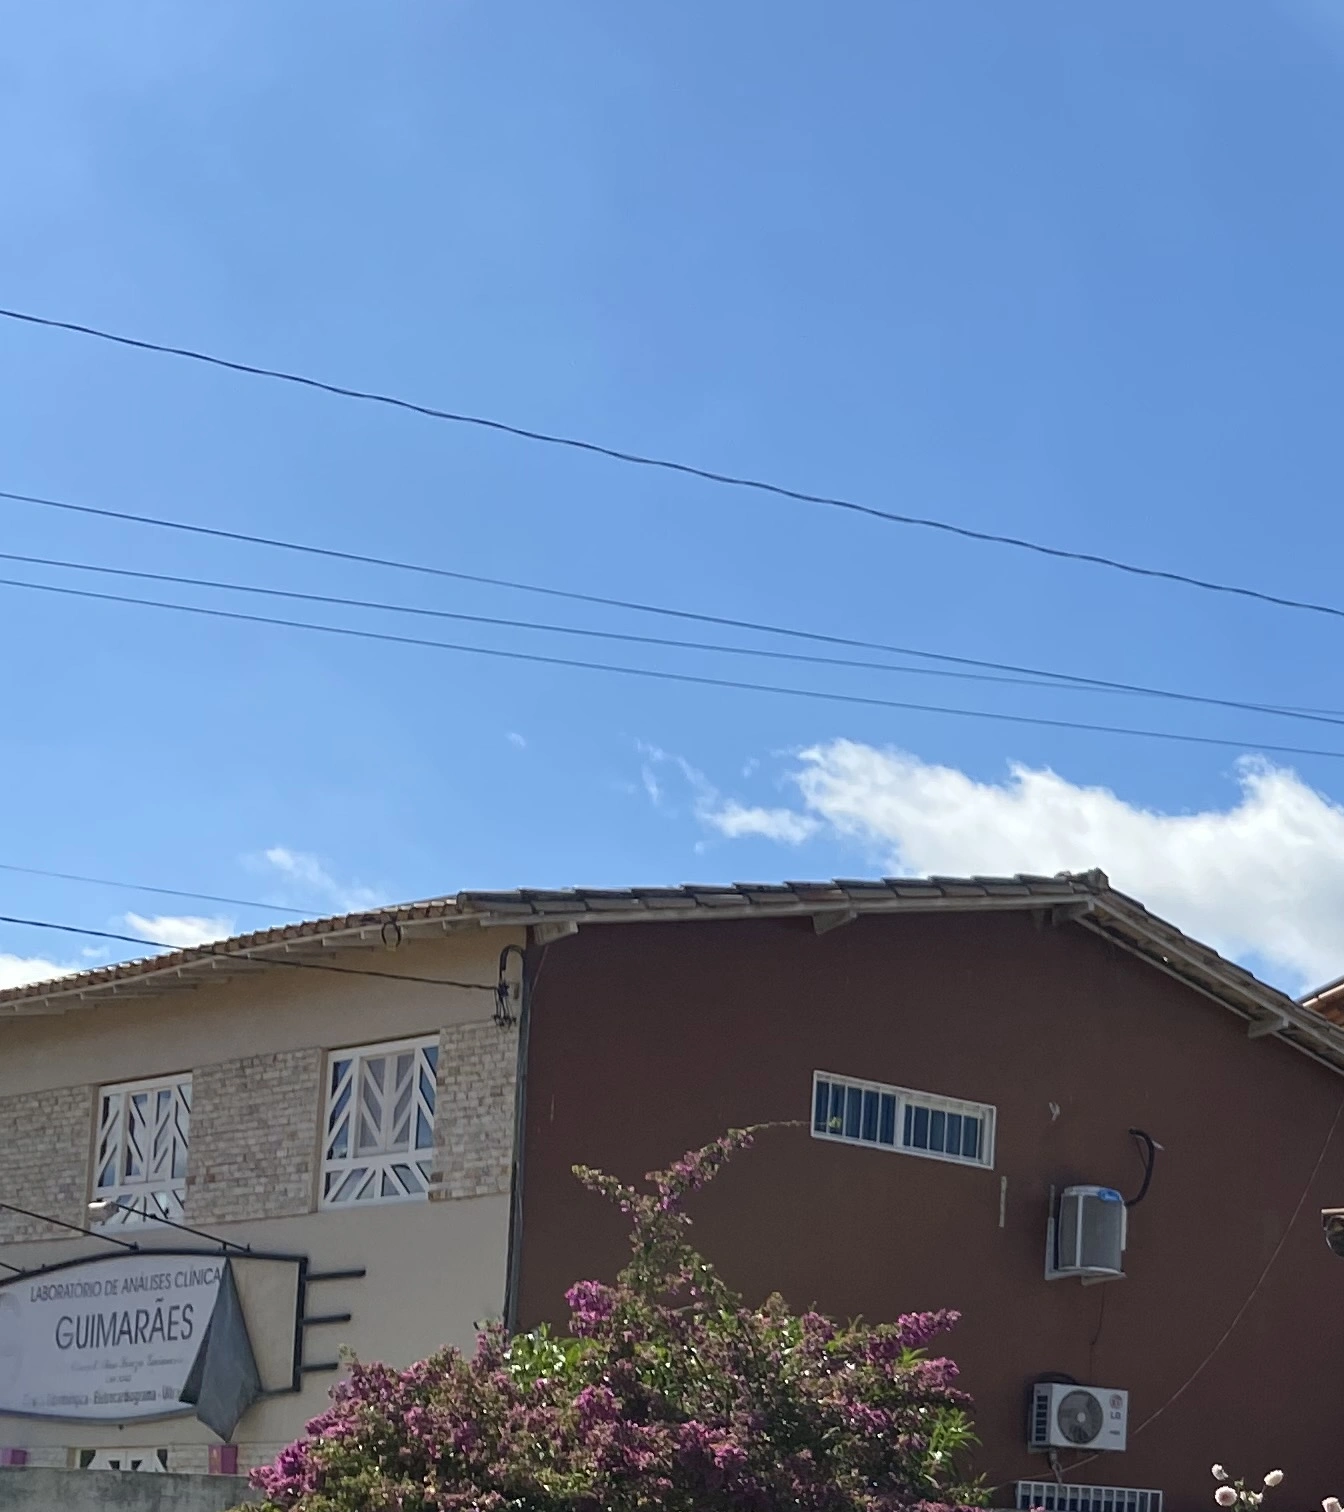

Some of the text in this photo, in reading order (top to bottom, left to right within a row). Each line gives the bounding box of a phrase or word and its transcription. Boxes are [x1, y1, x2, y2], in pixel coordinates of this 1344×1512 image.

[30, 1278, 101, 1302] LABORATÓRIO
[104, 1278, 119, 1297] DE
[121, 1270, 171, 1294] ANÁLISES
[55, 1297, 194, 1350] GUIMARÃES
